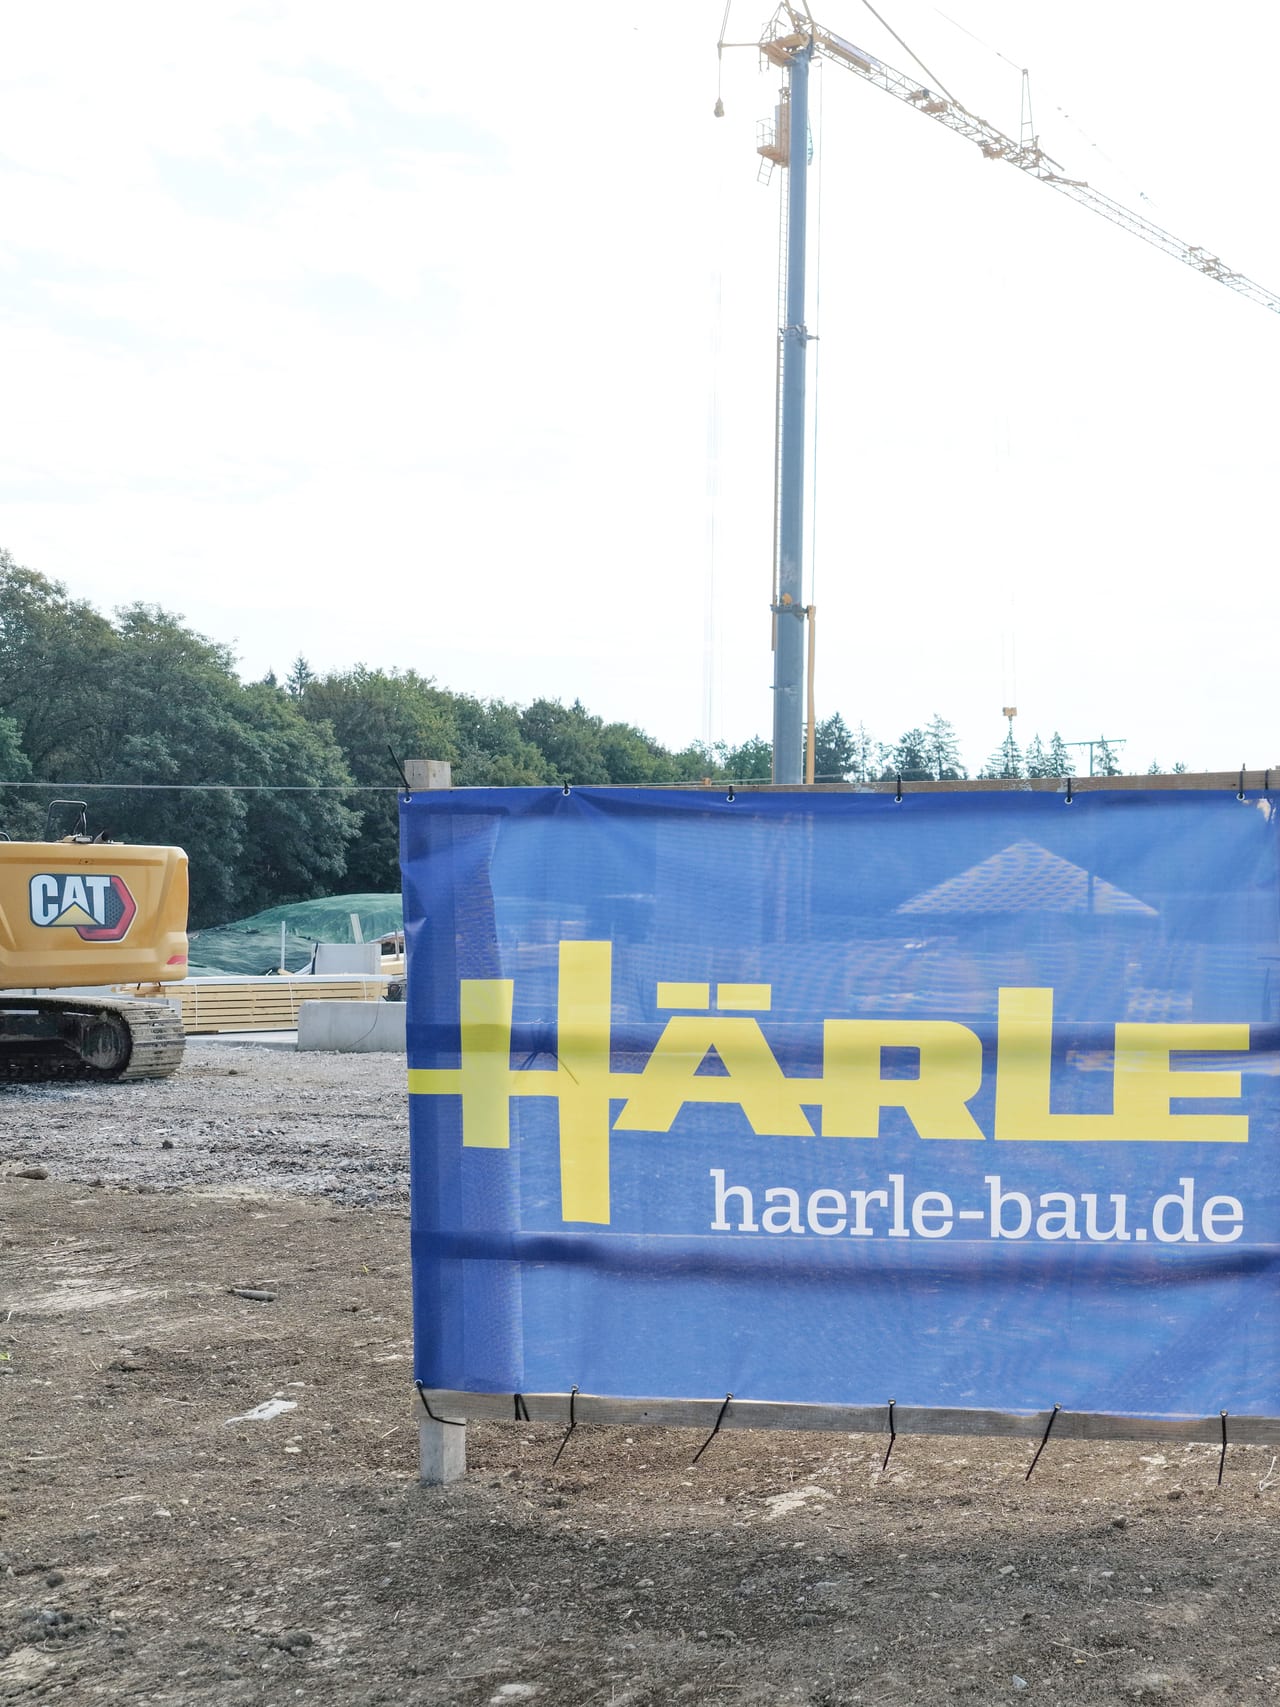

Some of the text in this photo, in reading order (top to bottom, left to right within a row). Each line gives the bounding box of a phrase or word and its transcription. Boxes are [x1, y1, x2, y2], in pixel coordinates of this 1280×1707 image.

[31, 875, 111, 925] CAT
[408, 940, 1250, 1225] HÄRLE
[709, 1168, 1245, 1244] haerle-bau.de
